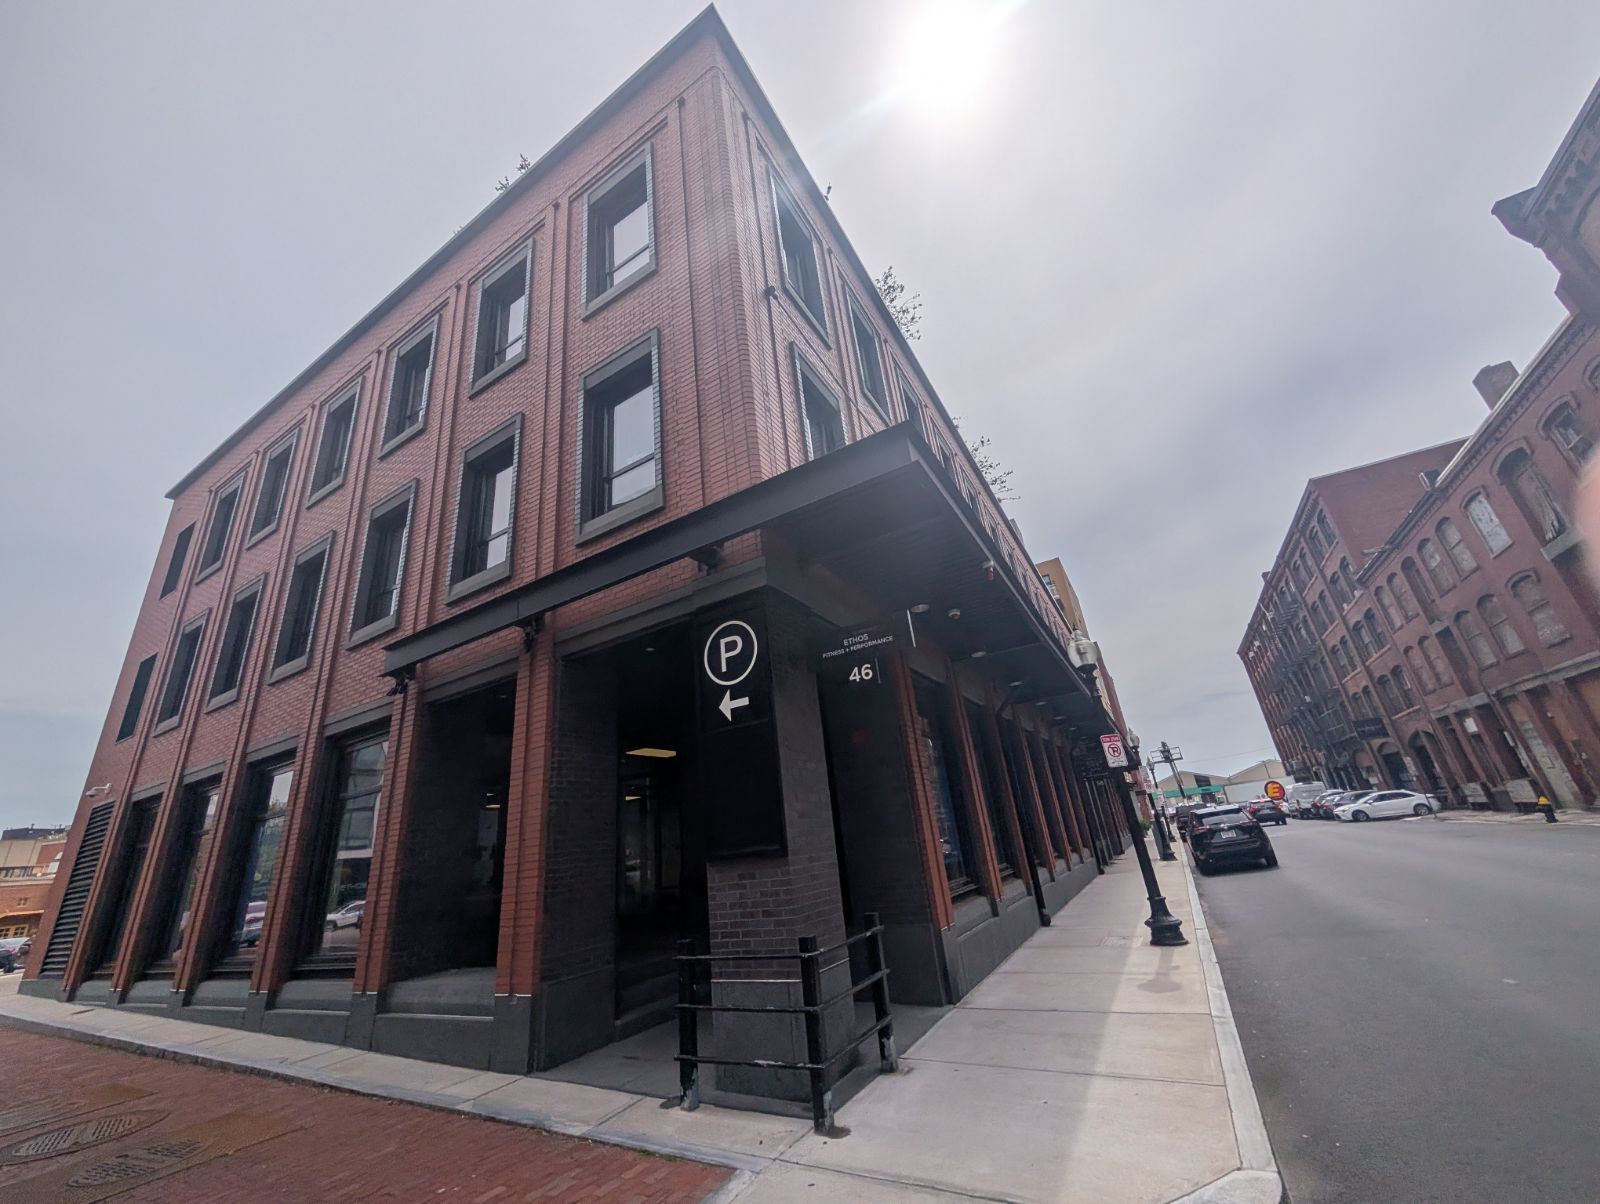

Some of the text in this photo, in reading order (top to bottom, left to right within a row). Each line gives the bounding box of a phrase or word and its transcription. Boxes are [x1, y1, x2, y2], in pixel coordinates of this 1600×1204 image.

[822, 648, 845, 659] FITNESS
[850, 635, 893, 652] PERFORMANCE
[843, 634, 869, 646] ETHOS
[719, 635, 743, 673] P
[849, 663, 873, 682] 46
